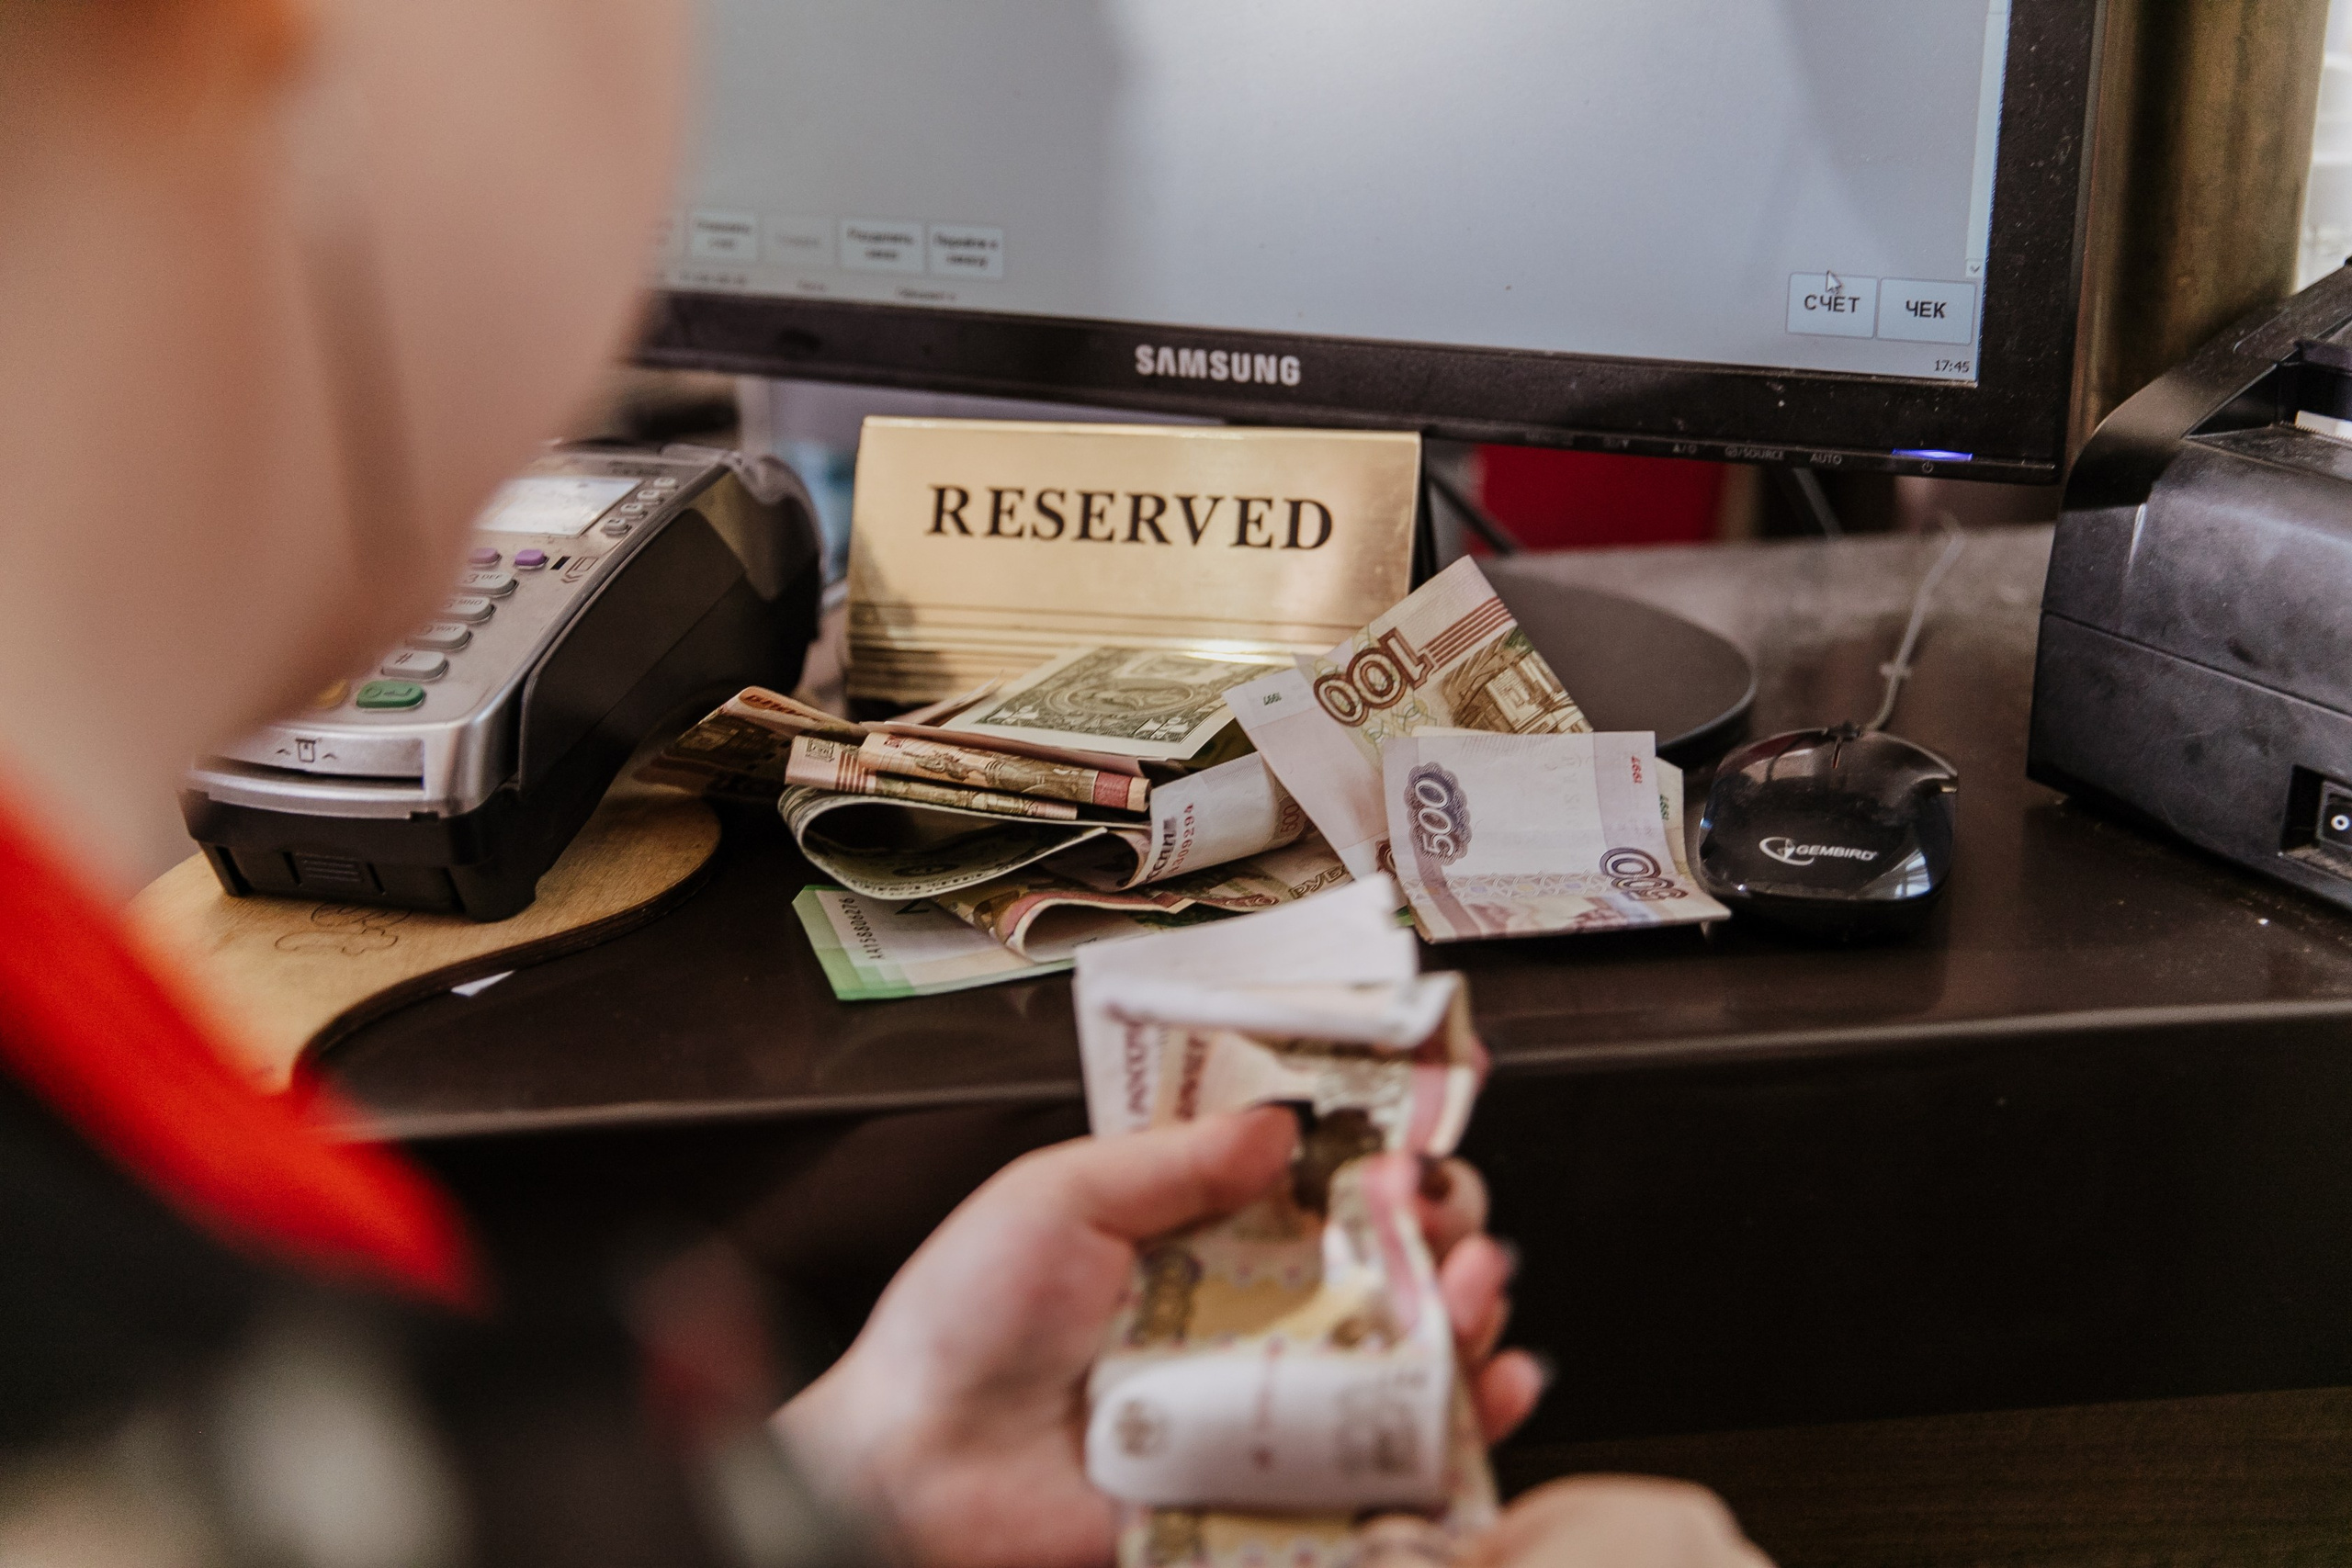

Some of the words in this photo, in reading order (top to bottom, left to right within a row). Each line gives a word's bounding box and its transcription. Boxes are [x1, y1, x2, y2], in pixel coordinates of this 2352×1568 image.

[1905, 299, 1947, 319] ЧЕК
[1135, 344, 1301, 387] SAMSUNG
[1934, 358, 1971, 374] 17:45
[1809, 452, 1843, 465] AUTO
[924, 483, 1335, 551] RESERVED
[1314, 626, 1434, 728] 100
[1262, 691, 1283, 707] 1997
[1631, 755, 1643, 784] 1997
[1415, 778, 1454, 857] 500
[1796, 844, 1878, 862] GEMBIRD
[1288, 864, 1348, 899] РУБ
